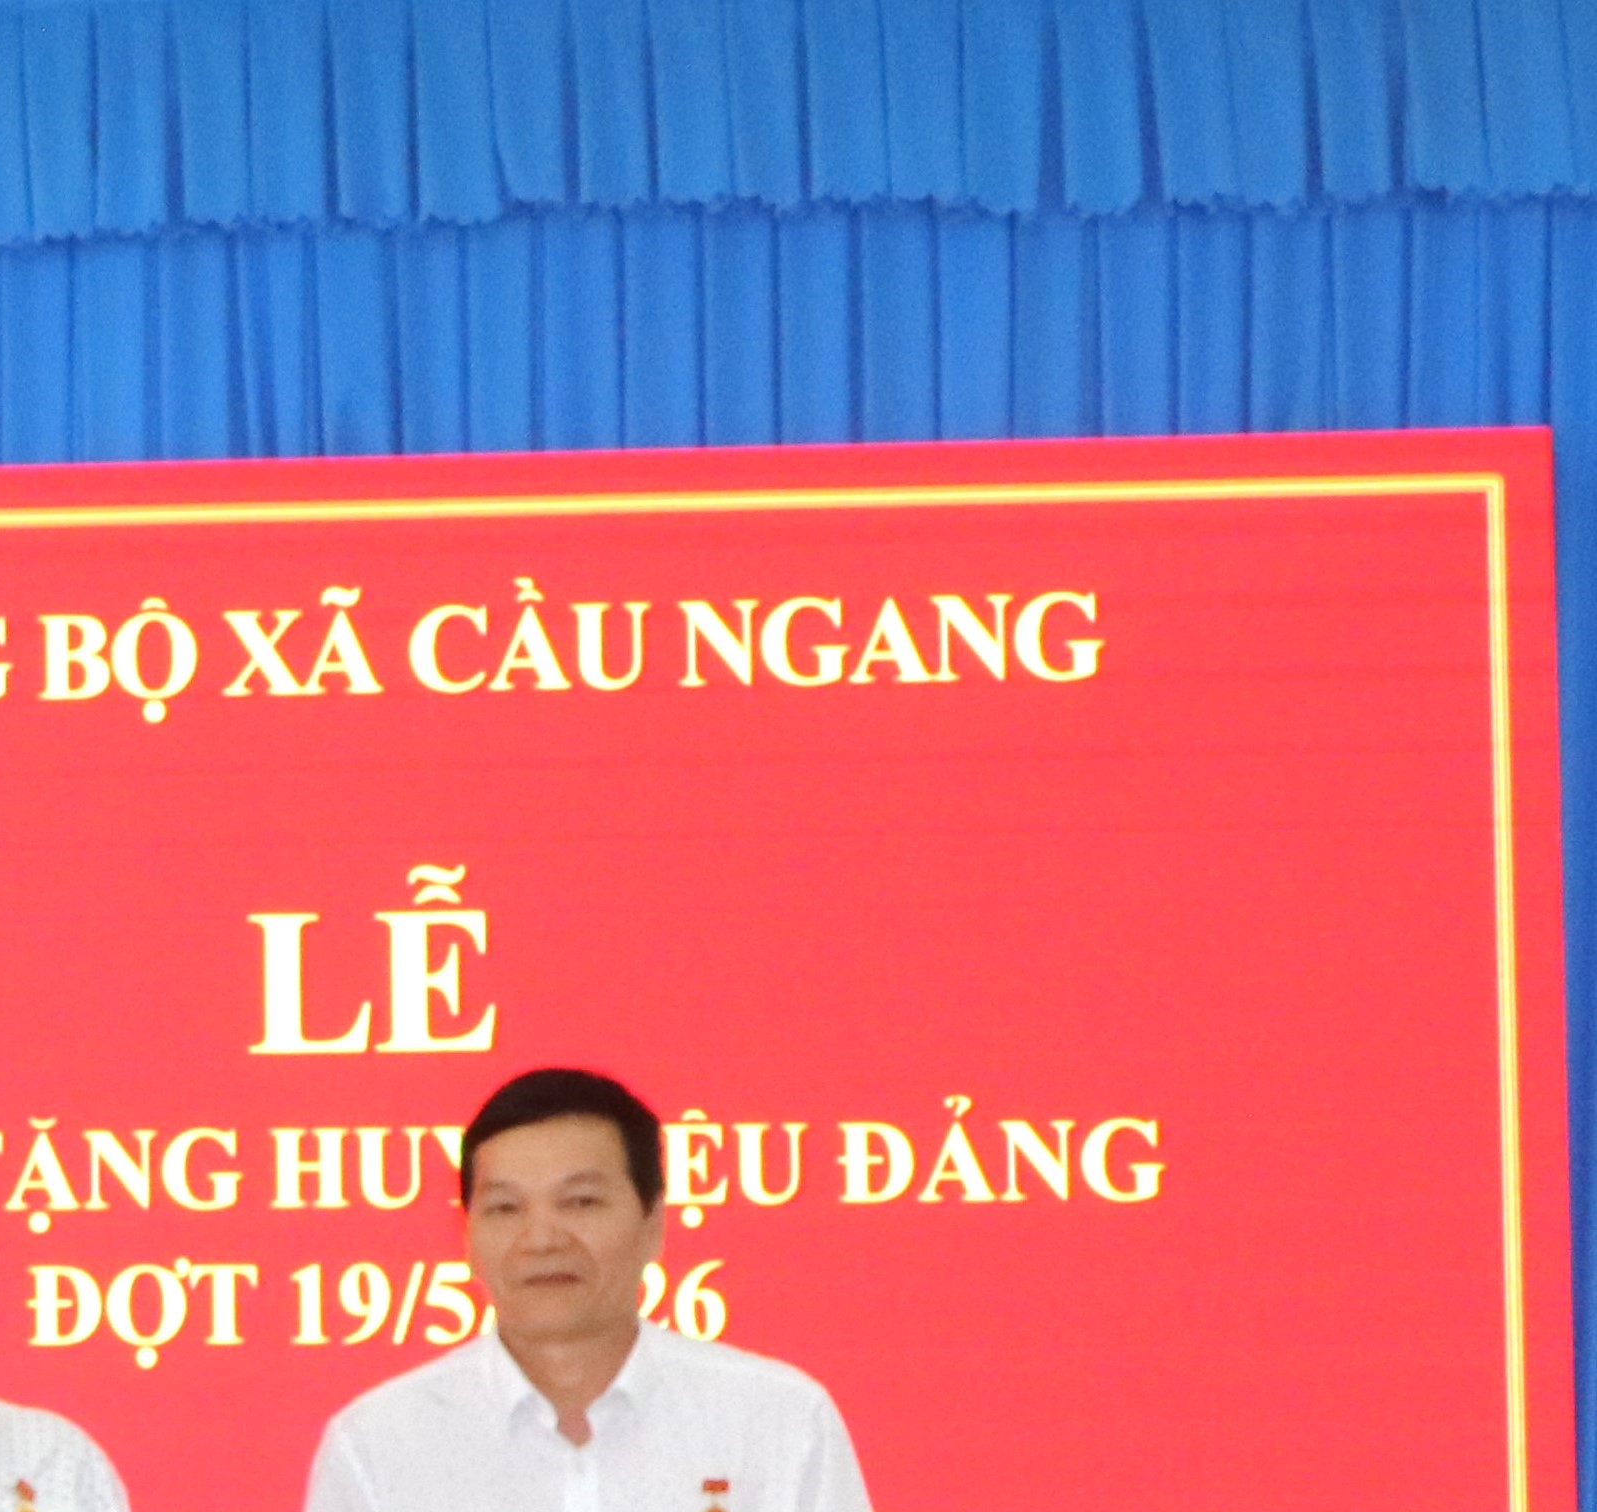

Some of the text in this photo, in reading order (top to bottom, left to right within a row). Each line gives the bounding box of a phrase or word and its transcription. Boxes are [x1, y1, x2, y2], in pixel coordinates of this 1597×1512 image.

[36, 596, 200, 724] BỘ
[221, 585, 384, 697] XÃ
[408, 577, 651, 693] CẦU
[677, 591, 1104, 688] NGANG
[246, 863, 497, 1055] LỄ
[837, 1094, 1166, 1204] ĐẢNG
[26, 1256, 259, 1370] ĐỢT
